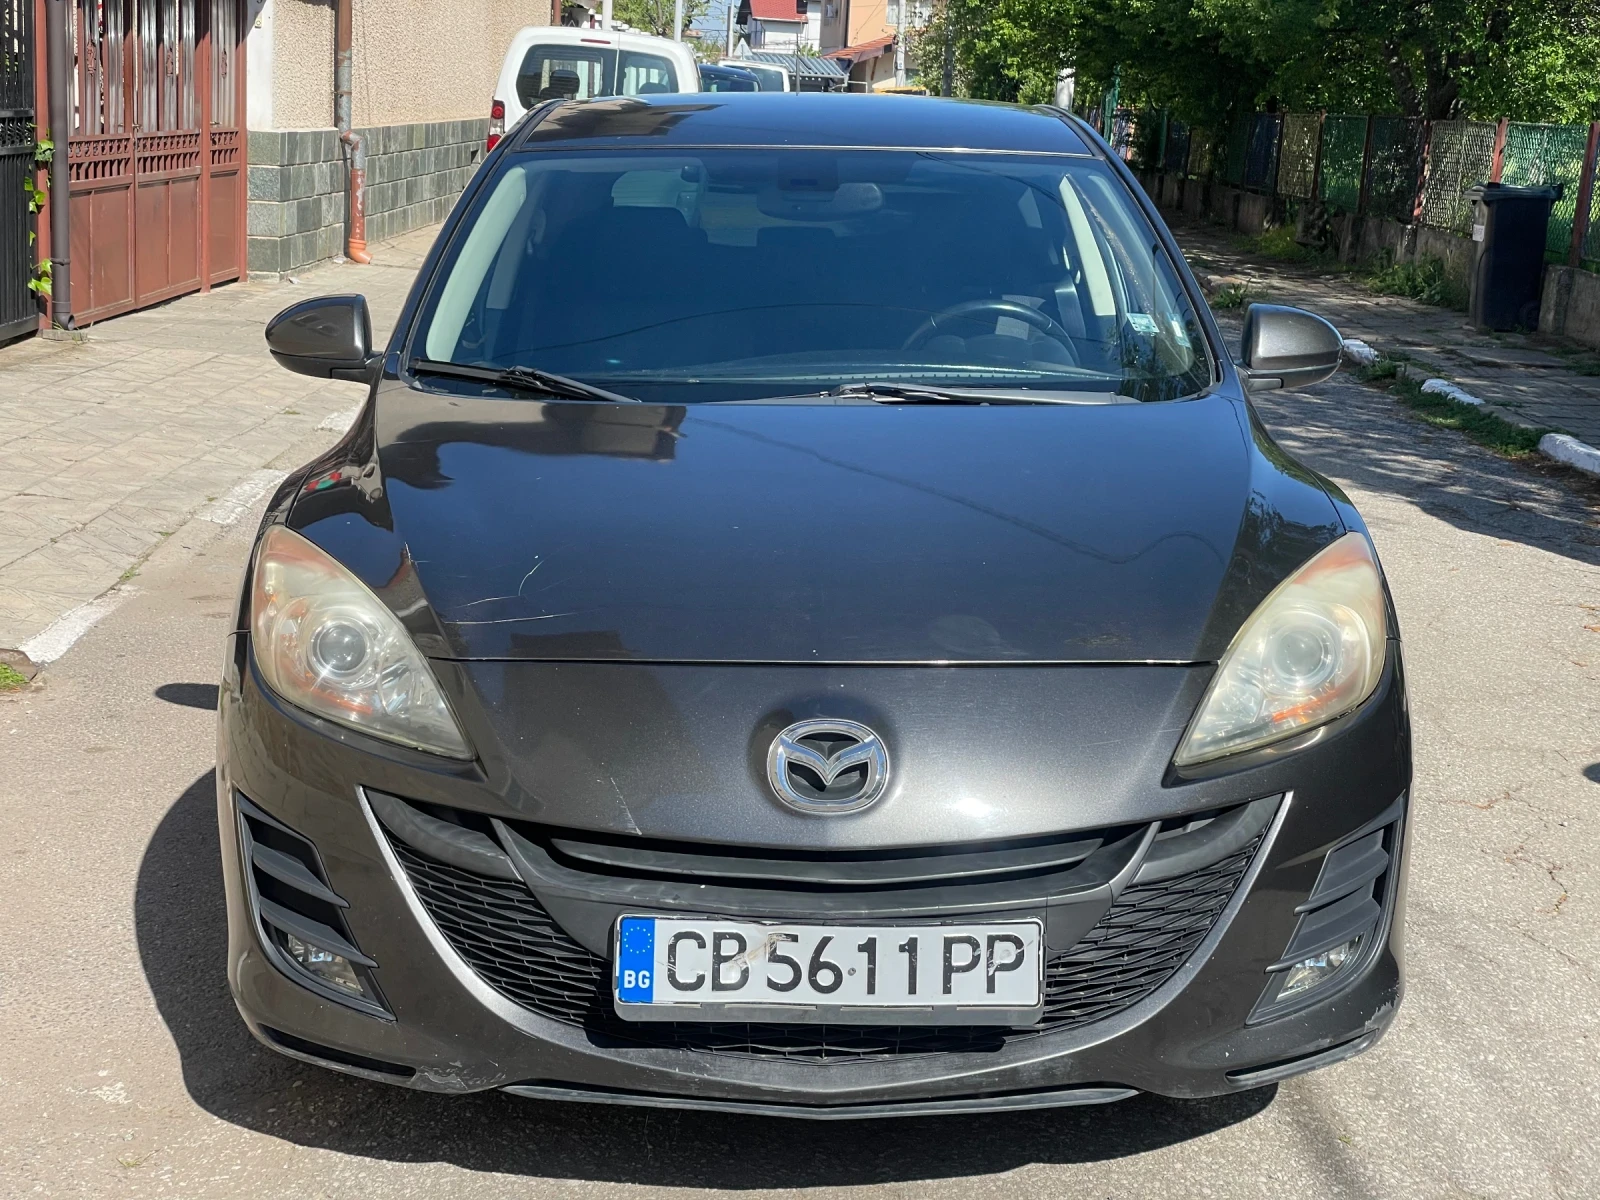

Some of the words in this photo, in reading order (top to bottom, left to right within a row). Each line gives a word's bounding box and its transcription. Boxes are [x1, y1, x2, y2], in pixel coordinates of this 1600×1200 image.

[624, 970, 650, 989] BG
[667, 931, 748, 992] CB
[767, 933, 918, 995] 5611
[943, 933, 1024, 994] PP
